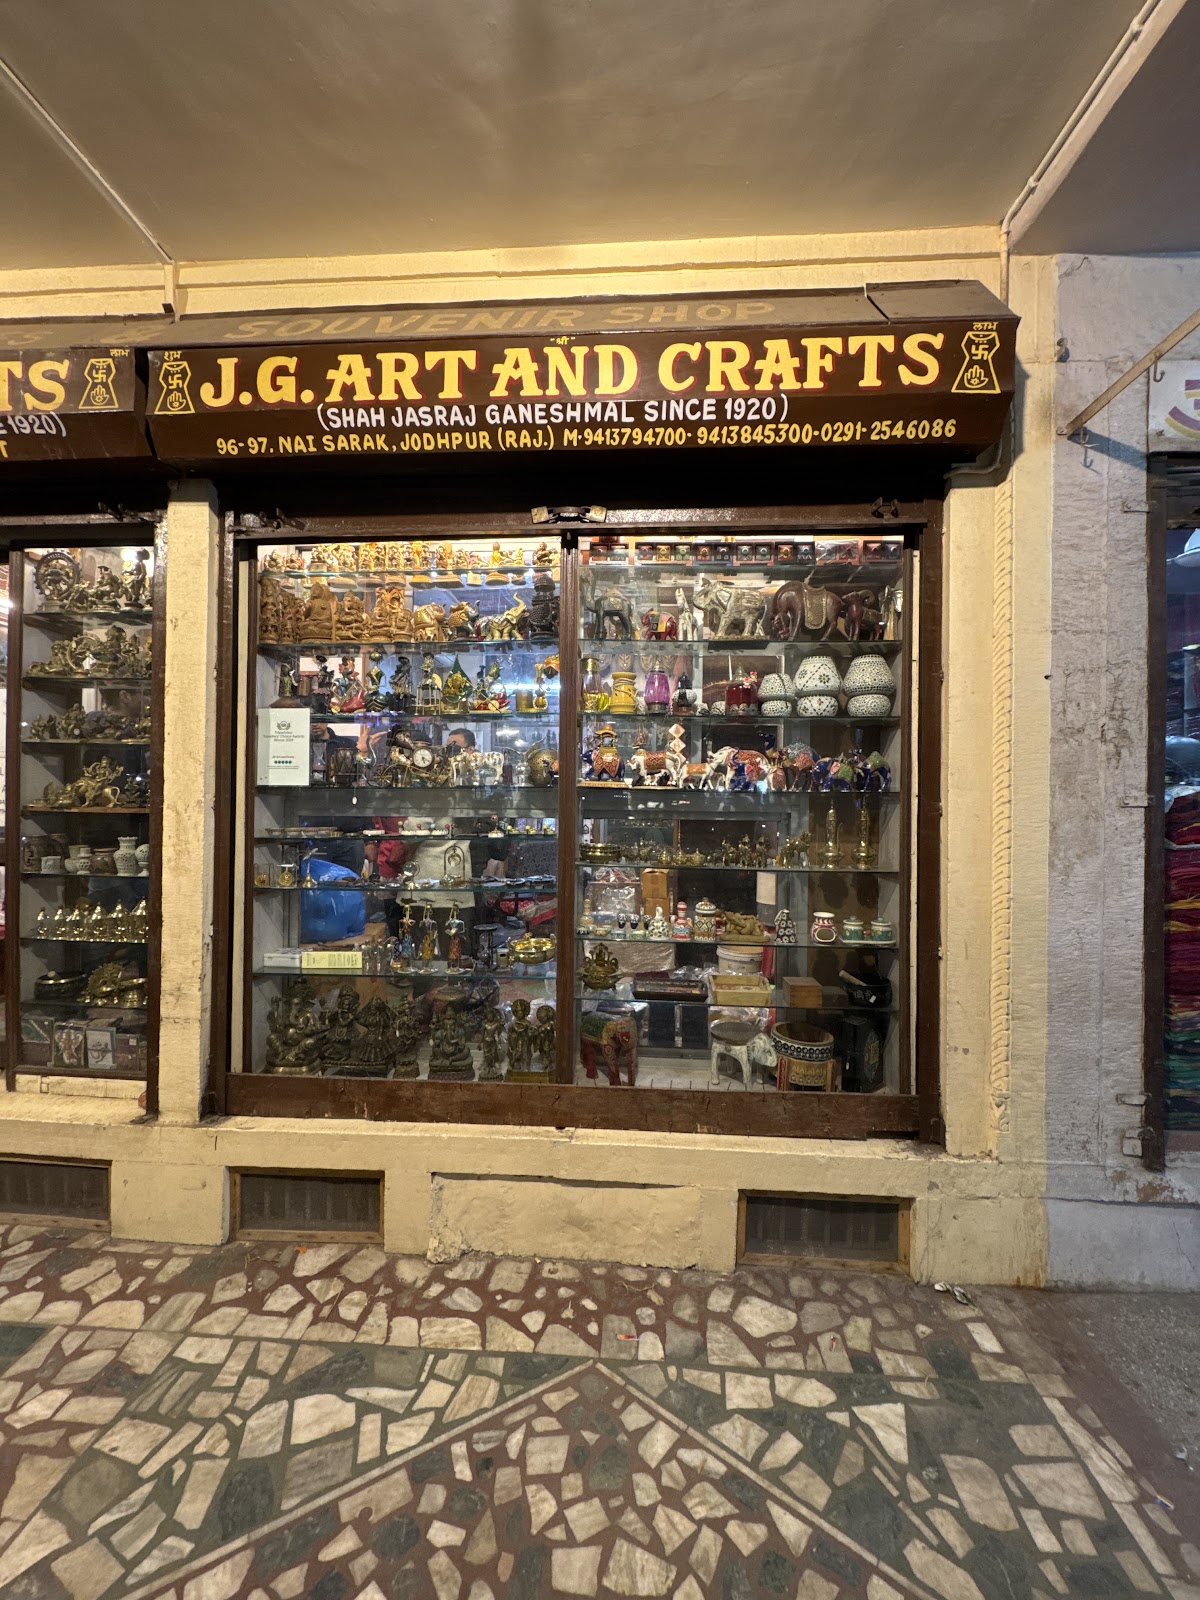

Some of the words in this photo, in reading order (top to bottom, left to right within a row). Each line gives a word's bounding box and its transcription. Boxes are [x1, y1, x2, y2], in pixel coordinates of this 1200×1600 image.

[224, 309, 585, 339] SOUVENIR
[602, 302, 775, 324] SHOP
[973, 321, 999, 331] लाभ
[163, 350, 183, 361] शुभ
[200, 355, 315, 408] J.G.
[325, 350, 477, 402] ART
[489, 344, 639, 397] AND
[658, 332, 945, 395] CRAFTS
[8, 411, 67, 437] 1920)
[317, 403, 386, 431] (SHAH
[391, 404, 477, 428] JASRAJ
[485, 401, 635, 425] GANESHMAL
[644, 398, 717, 423] SINCE
[724, 393, 788, 422] 1920)
[278, 435, 317, 454] NAI
[321, 433, 398, 452] SARAK,
[400, 431, 493, 451] JODHPUR
[497, 425, 555, 451] (RAJ.)
